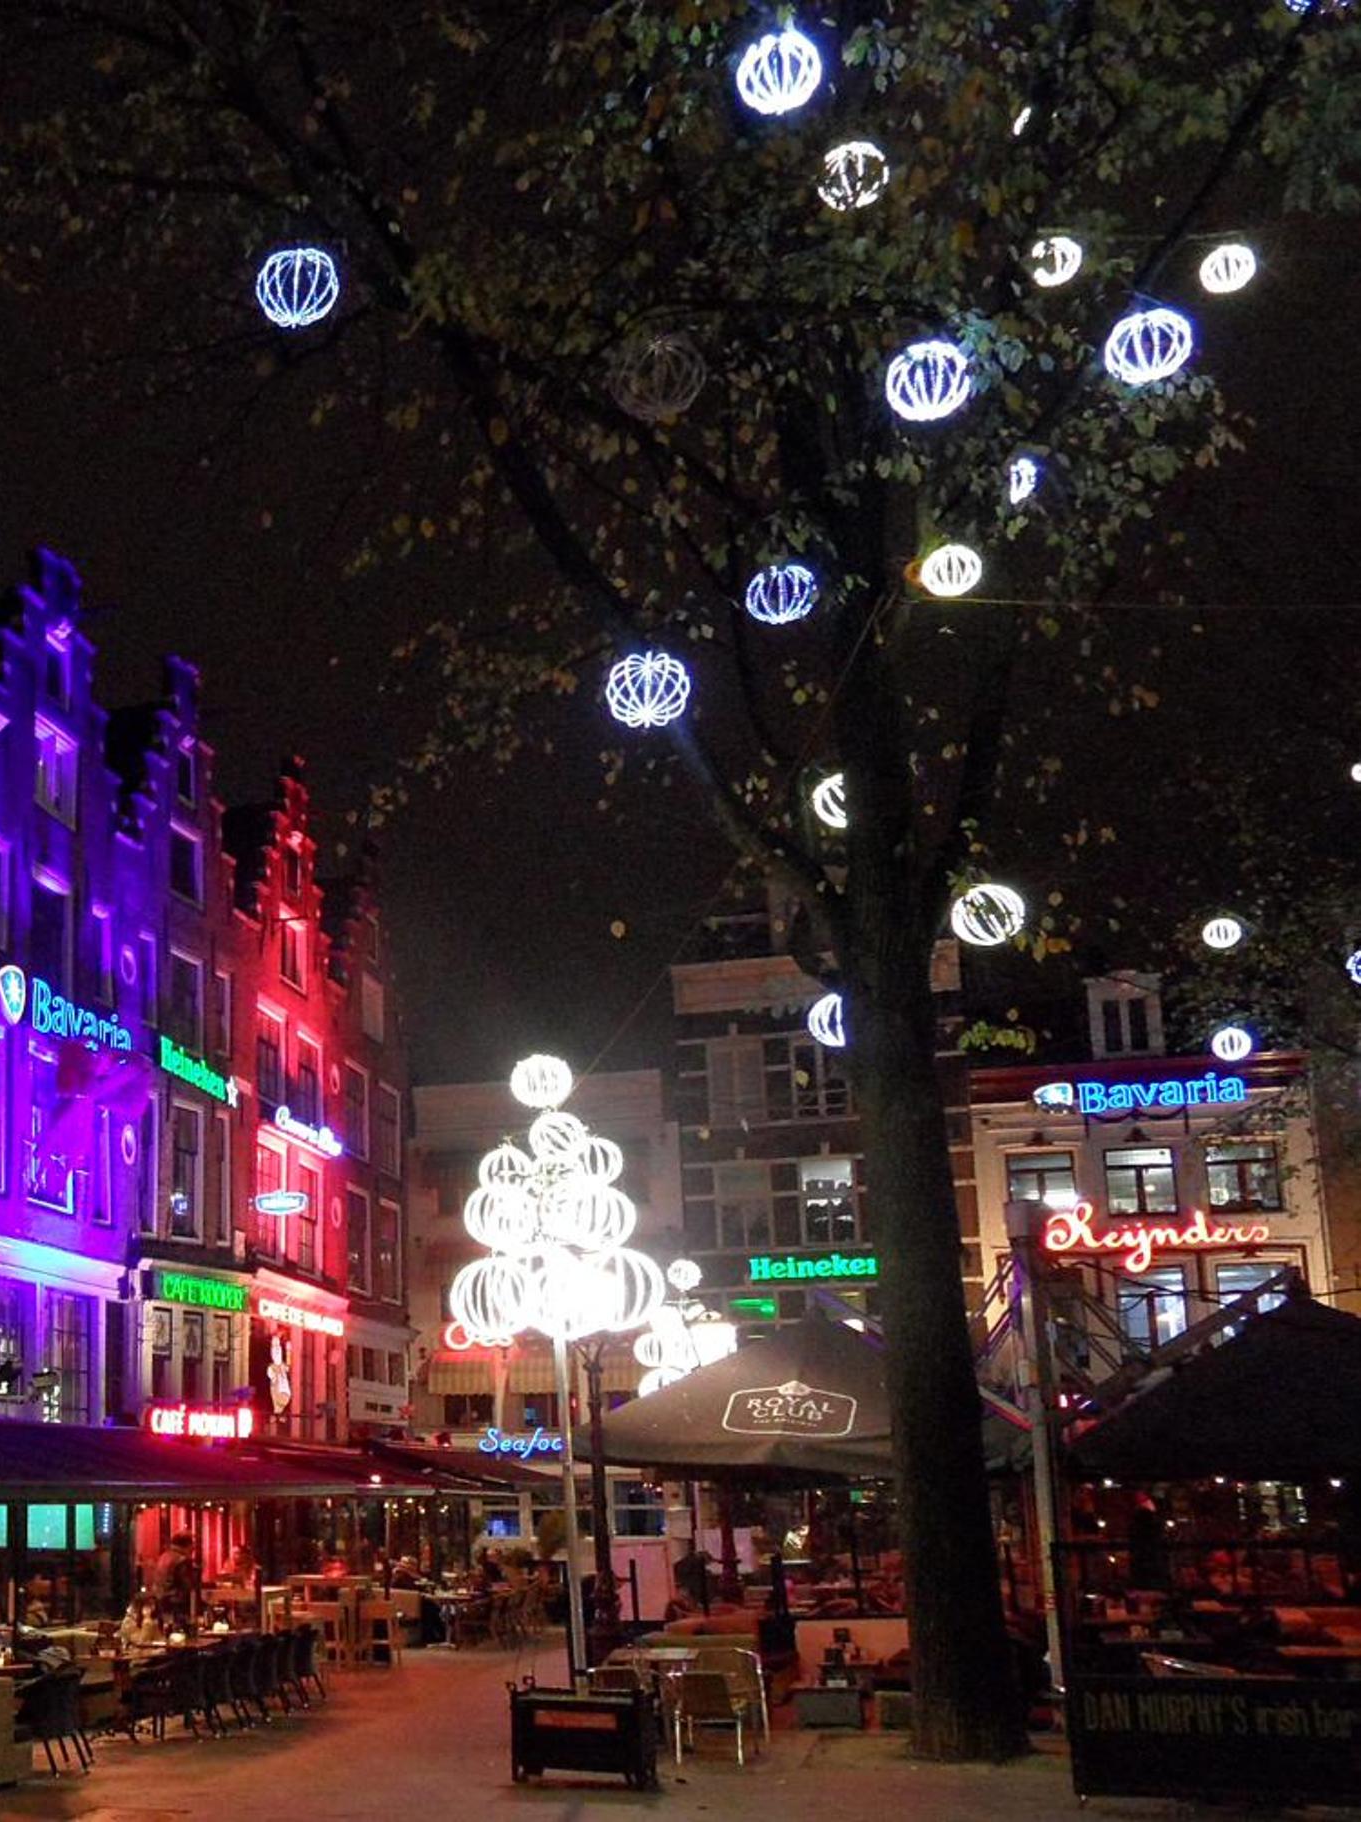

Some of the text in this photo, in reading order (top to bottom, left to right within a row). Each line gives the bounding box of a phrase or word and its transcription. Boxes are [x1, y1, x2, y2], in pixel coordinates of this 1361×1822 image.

[32, 977, 133, 1051] Bavaria
[160, 1035, 226, 1101] Heineken
[1078, 1072, 1247, 1114] Bavaria
[1045, 1201, 1270, 1273] Reijnders
[746, 1395, 835, 1413] ROYAL
[752, 1406, 824, 1422] CLUB
[1083, 1691, 1131, 1731] DAN
